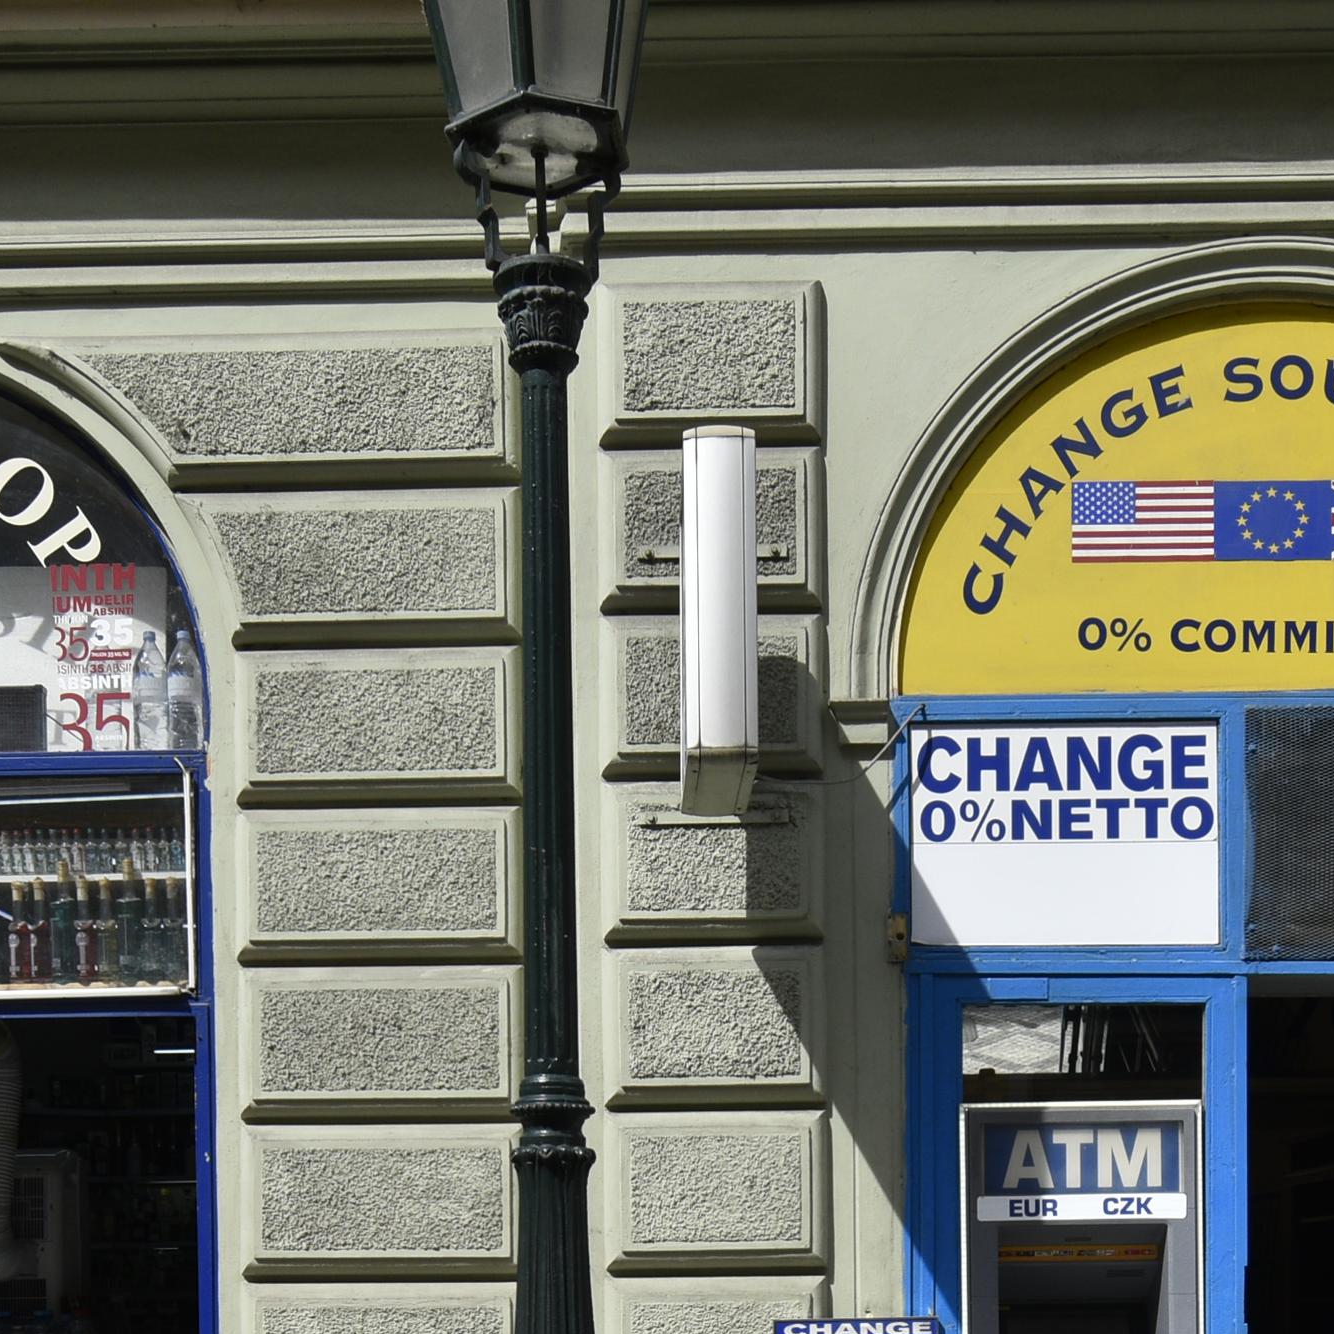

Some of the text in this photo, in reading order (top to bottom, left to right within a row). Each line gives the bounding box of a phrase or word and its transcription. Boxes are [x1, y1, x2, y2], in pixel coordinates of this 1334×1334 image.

[963, 364, 1195, 615] CHANGE
[90, 618, 133, 647] 35
[1077, 616, 1152, 654] 0%
[60, 692, 131, 751] 35
[916, 733, 1209, 793] CHANGE
[1002, 1128, 1162, 1191] ATM
[1009, 1196, 1153, 1218] EUR CZK
